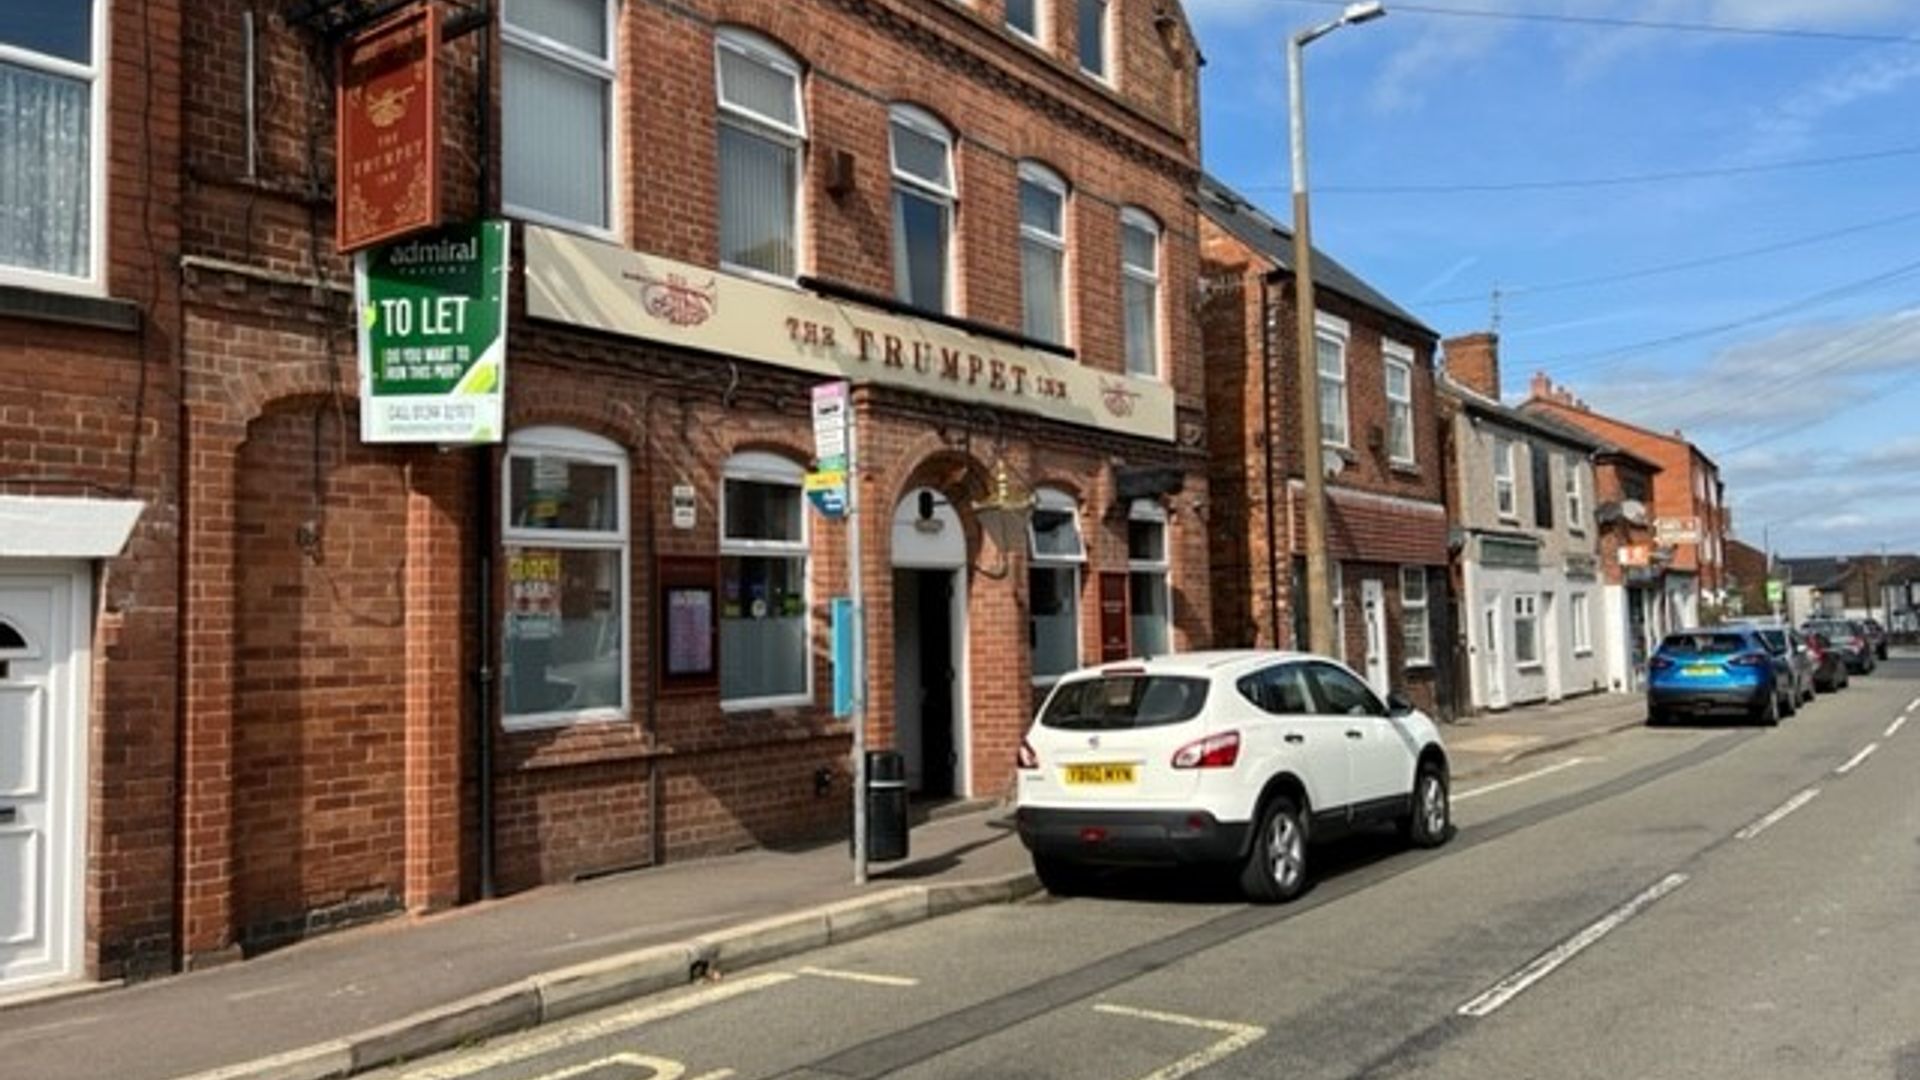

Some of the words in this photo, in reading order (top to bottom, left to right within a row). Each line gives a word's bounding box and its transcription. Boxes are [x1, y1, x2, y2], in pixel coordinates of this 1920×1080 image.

[389, 236, 478, 265] admiral
[381, 298, 412, 337] TO
[421, 296, 470, 335] LET
[785, 317, 836, 348] THE
[853, 326, 1028, 396] TRUMPET
[1036, 376, 1069, 399] INN
